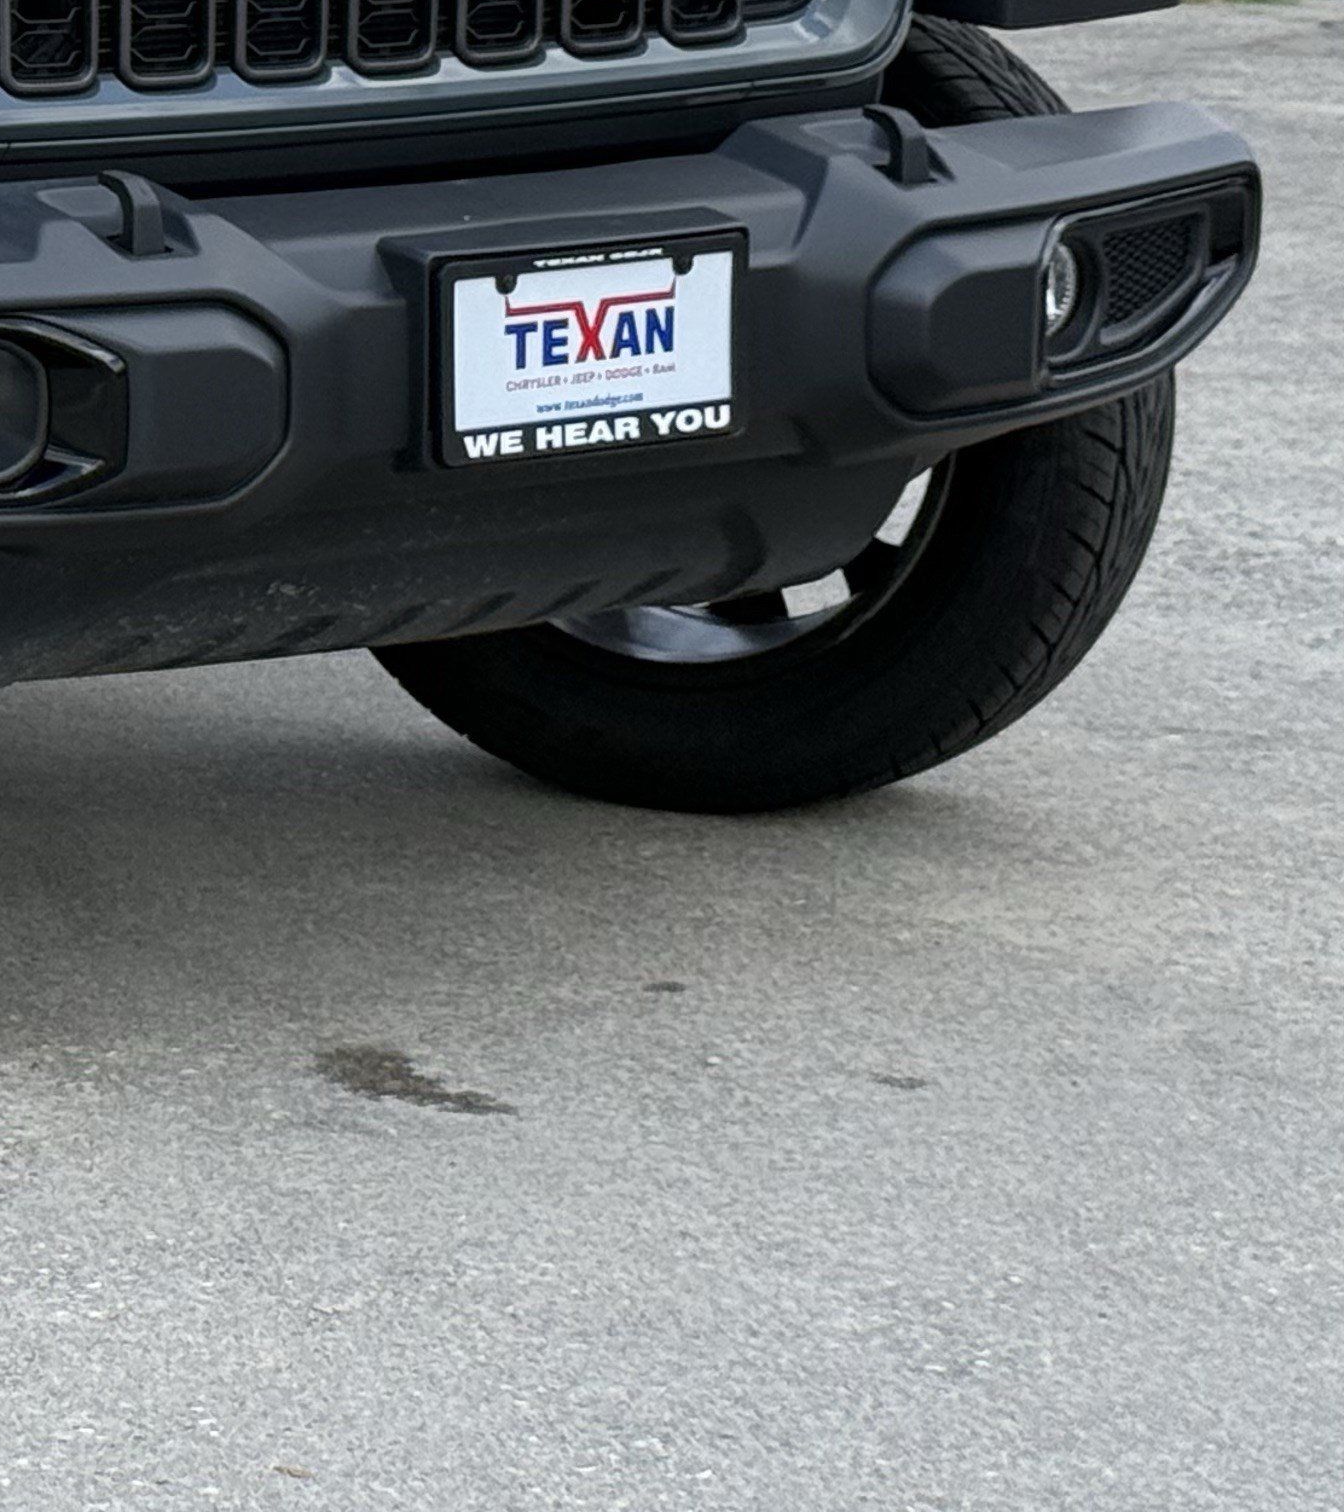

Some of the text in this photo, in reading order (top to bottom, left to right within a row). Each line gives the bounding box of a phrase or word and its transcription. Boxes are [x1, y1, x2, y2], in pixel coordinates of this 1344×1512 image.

[504, 302, 675, 370] TEXAN
[506, 376, 562, 392] CHRYSLER
[570, 371, 595, 386] JEEP
[605, 366, 643, 381] DODGE
[463, 404, 732, 459] WE HEAR YOU
